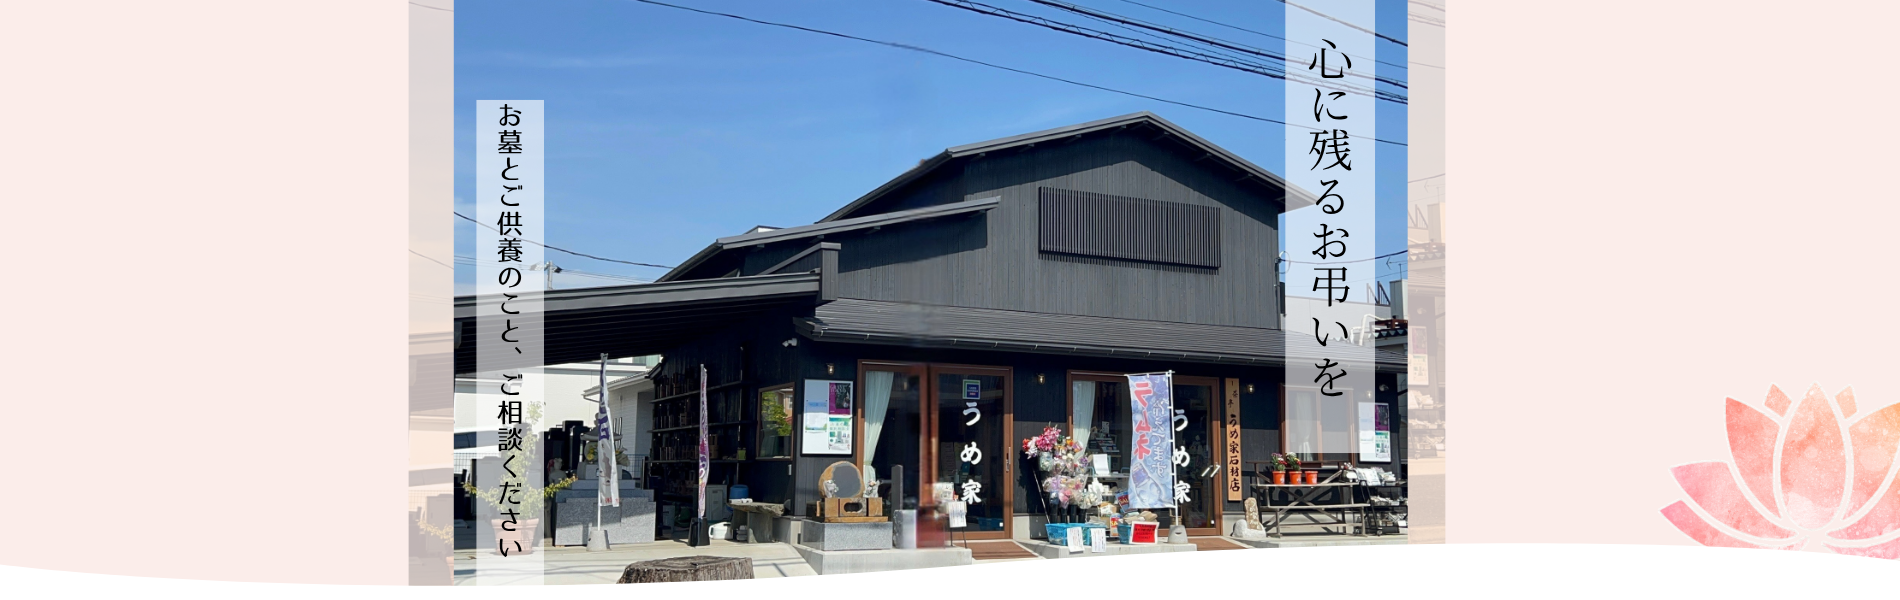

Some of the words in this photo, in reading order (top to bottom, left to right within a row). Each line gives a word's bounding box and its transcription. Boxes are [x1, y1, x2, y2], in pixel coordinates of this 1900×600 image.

[960, 402, 982, 504] うめ家
[1229, 413, 1240, 492] うめ家石材店
